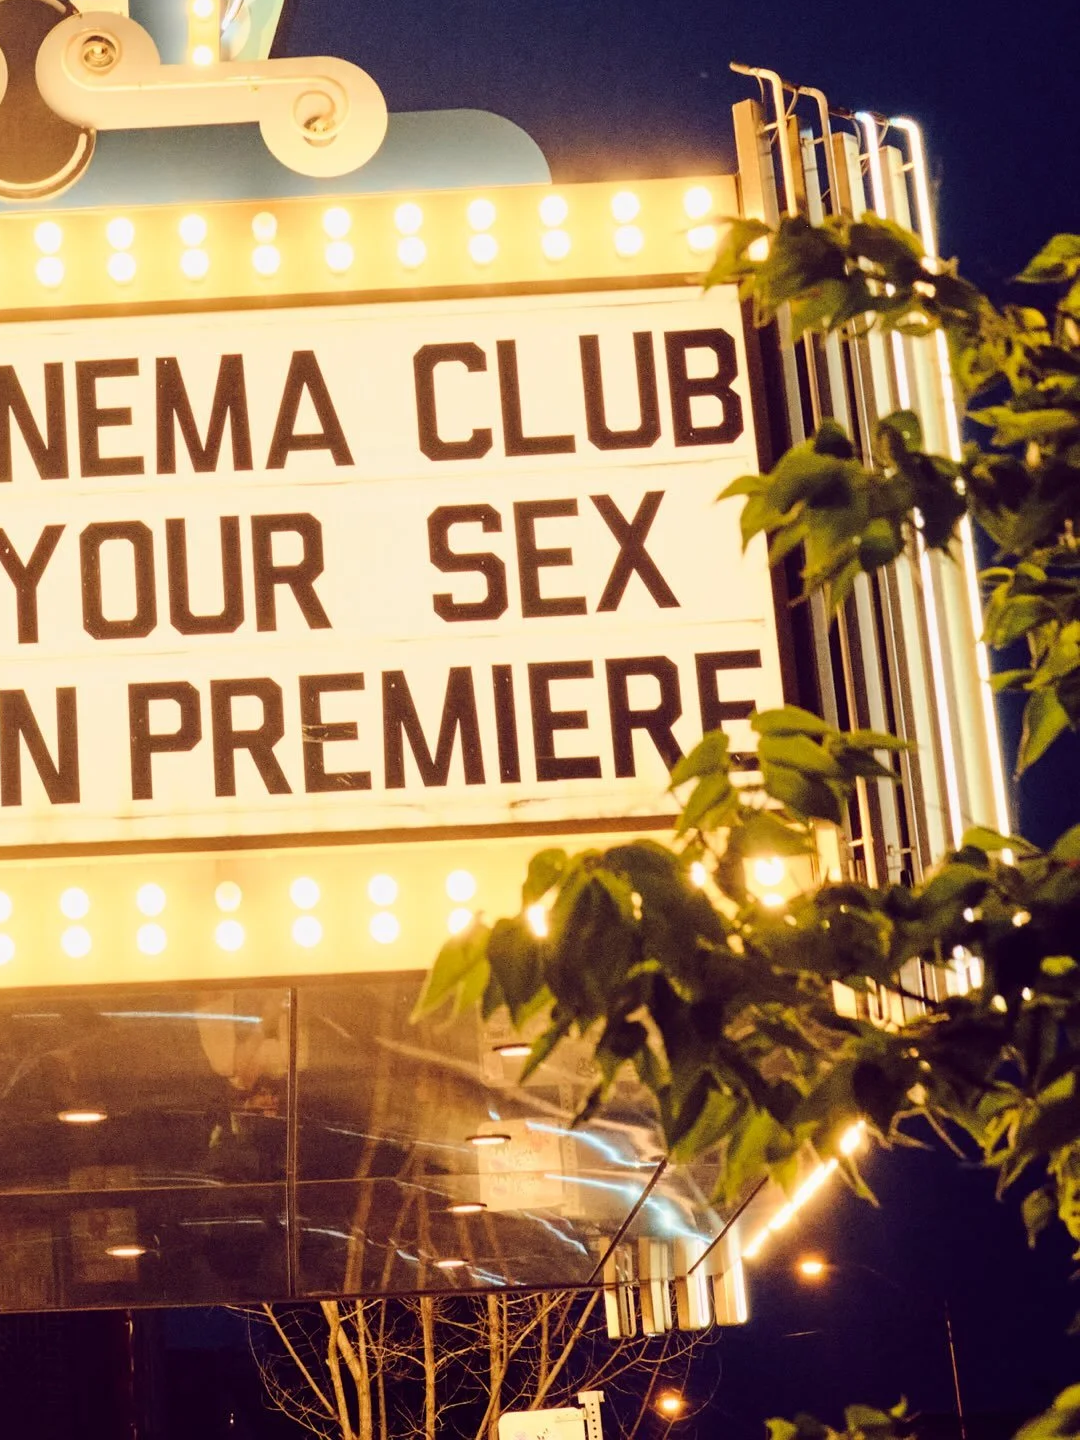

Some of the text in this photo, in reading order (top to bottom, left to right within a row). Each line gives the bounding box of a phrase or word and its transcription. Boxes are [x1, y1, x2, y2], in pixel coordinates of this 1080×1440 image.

[413, 327, 745, 462] CLUB
[427, 490, 680, 623] SEX
[128, 649, 763, 802] PREMIERE
